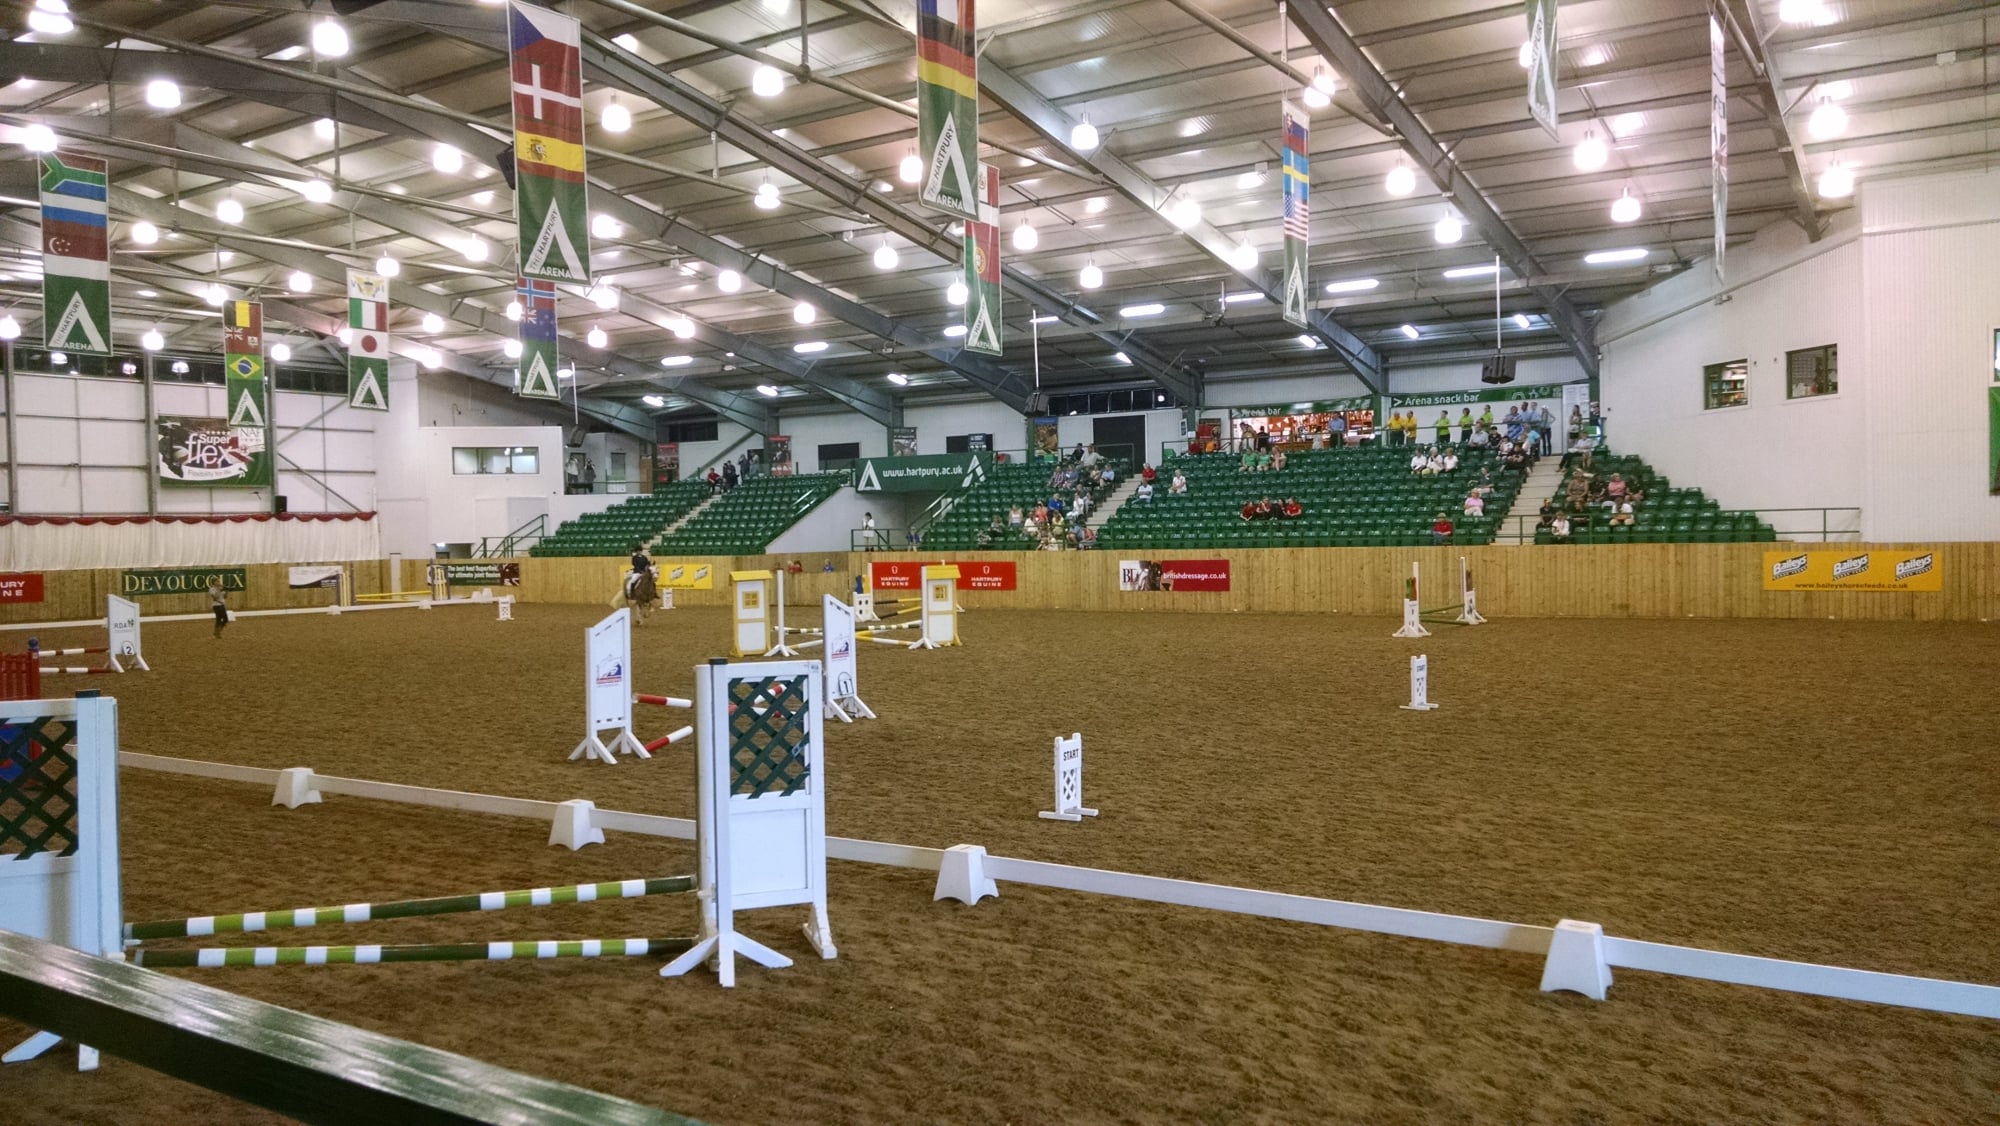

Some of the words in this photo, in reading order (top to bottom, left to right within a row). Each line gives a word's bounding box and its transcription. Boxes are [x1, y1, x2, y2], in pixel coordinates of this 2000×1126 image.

[933, 124, 955, 181] HARTPURY
[936, 194, 965, 212] ARENA
[529, 252, 542, 270] THE
[537, 209, 558, 255] HARTPURY
[540, 266, 572, 279] ARENA
[61, 300, 82, 333] HARTPURY
[63, 342, 94, 351] ARENA
[1405, 397, 1433, 406] Arena
[1434, 395, 1462, 405] snack
[1464, 394, 1479, 403] bar
[1241, 408, 1267, 417] Arena
[1267, 407, 1281, 415] bar
[199, 433, 231, 445] Super
[185, 433, 234, 465] flex
[883, 465, 963, 478] www.hartpury.ac.uk
[1773, 556, 1807, 574] Baileys
[1833, 555, 1869, 575] Baileys
[1895, 554, 1932, 574] Baileys
[1163, 572, 1227, 581] britishdressage.co.uk
[125, 645, 133, 655] 2
[843, 680, 849, 694] 1
[1063, 748, 1079, 761] START
